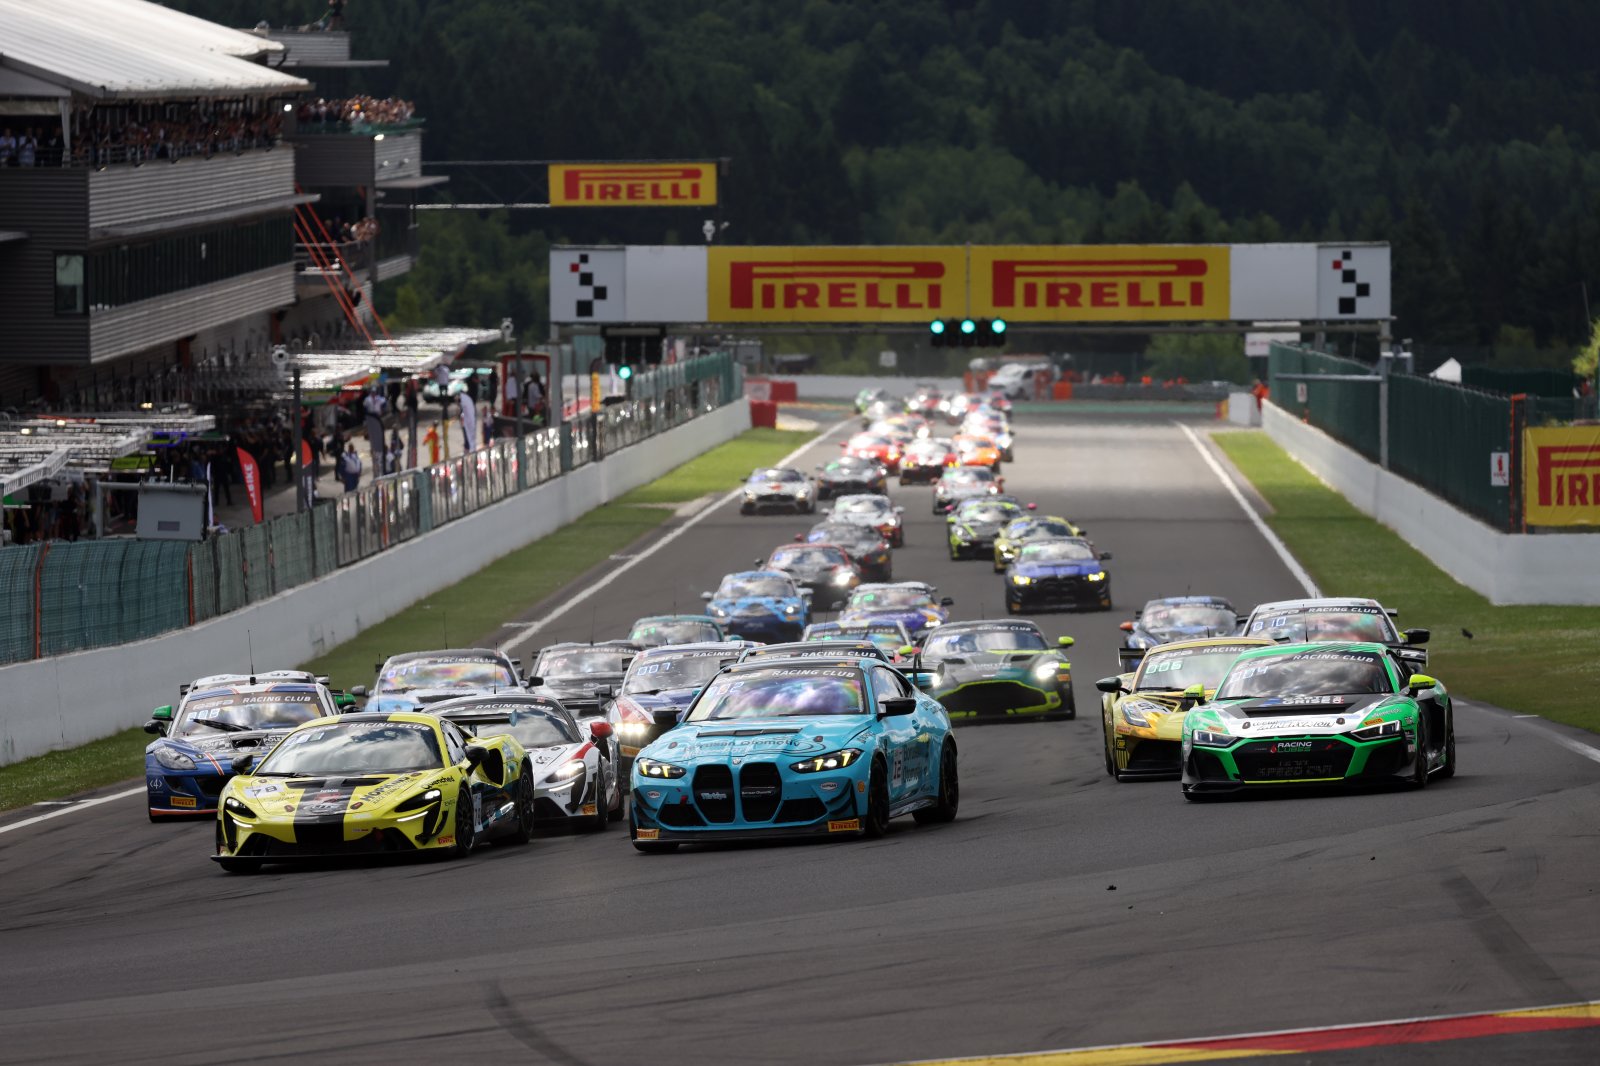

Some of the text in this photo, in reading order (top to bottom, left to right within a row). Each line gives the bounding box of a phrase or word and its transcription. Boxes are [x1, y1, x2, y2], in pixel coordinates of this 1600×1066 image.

[564, 168, 703, 200] PIRELLI
[729, 260, 946, 309] PIRELLI
[992, 258, 1209, 308] PIRELLI
[1202, 646, 1245, 654] RACING
[1342, 655, 1375, 663] CLUB
[636, 662, 671, 676] 007
[772, 669, 856, 678] RACING CLUB
[242, 695, 282, 704] RACING
[523, 703, 553, 711] CLUB
[398, 723, 431, 731] CLUB
[1277, 741, 1312, 749] RACING
[172, 797, 196, 806] PIRELLI
[830, 821, 858, 830] PIRELLI
